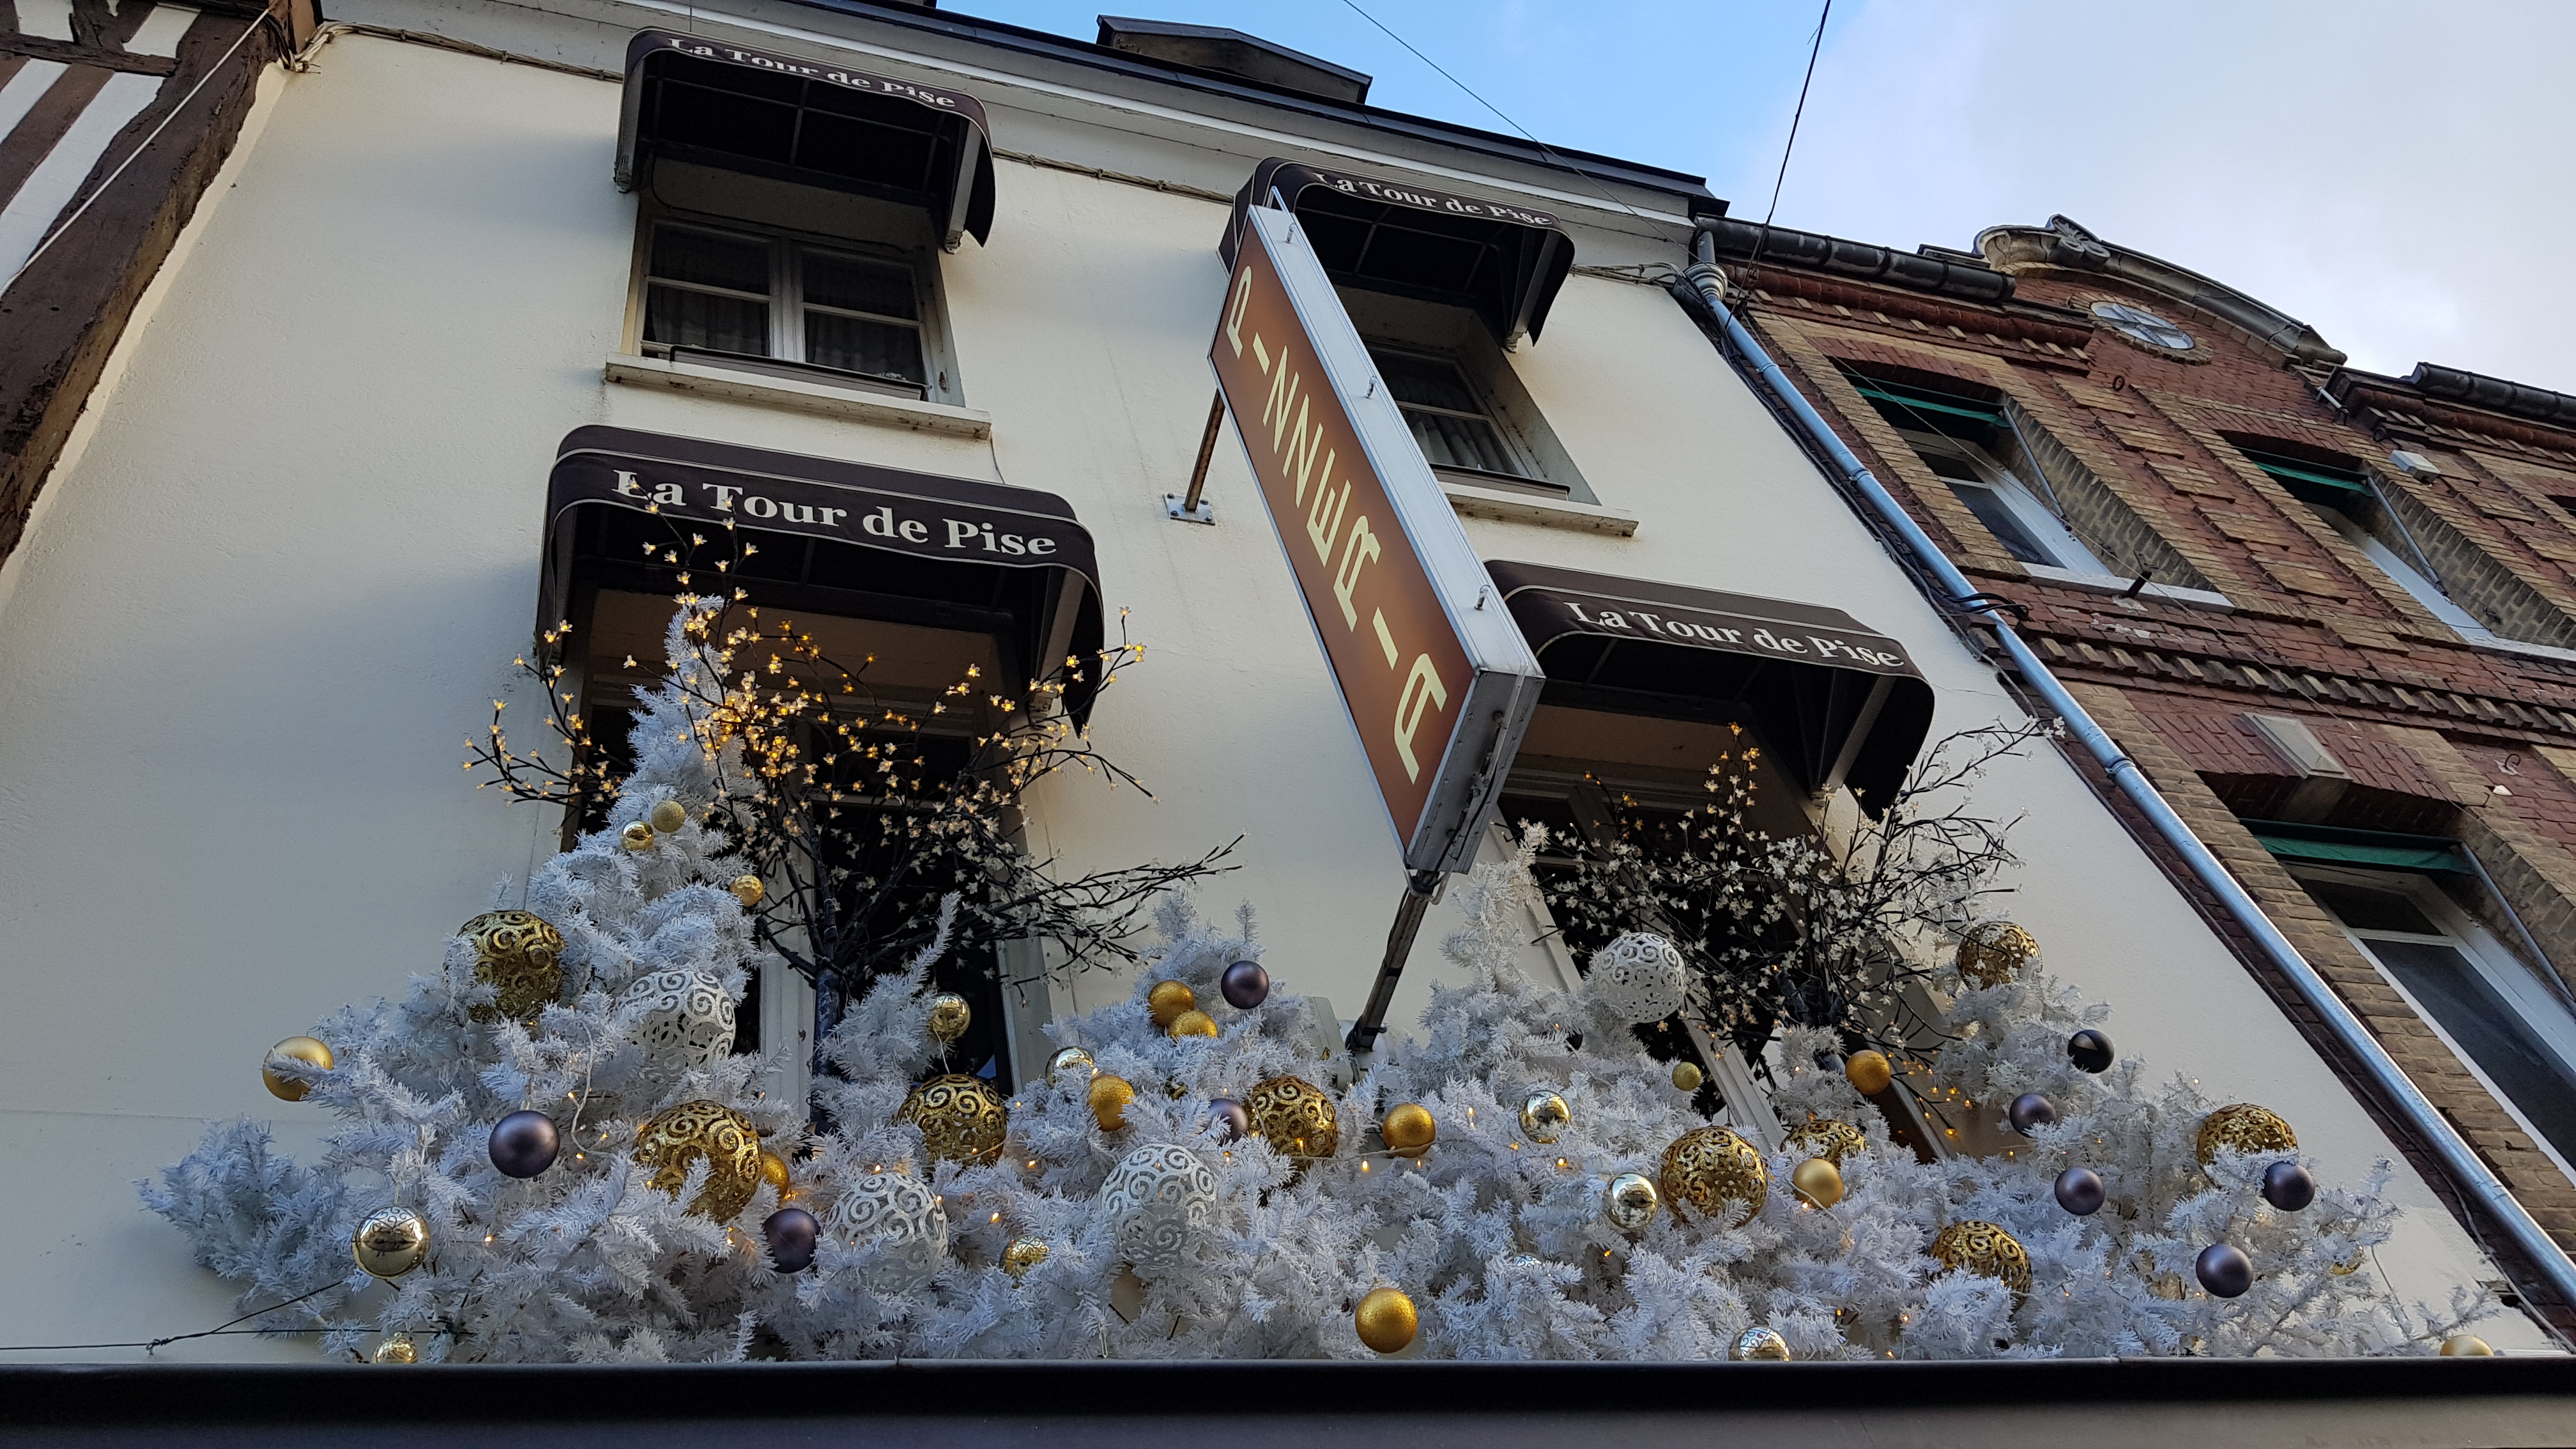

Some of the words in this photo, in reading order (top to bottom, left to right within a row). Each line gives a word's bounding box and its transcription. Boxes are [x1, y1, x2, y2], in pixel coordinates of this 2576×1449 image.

[668, 38, 713, 57] La
[724, 49, 819, 75] Tour
[827, 72, 871, 88] de
[880, 79, 956, 107] Pise
[1312, 172, 1358, 193] La
[1358, 181, 1437, 208] Tour
[1445, 197, 1483, 215] de
[1485, 204, 1552, 226] Pise
[611, 469, 687, 507] La
[702, 482, 847, 528] Tour
[862, 505, 928, 544] de
[942, 518, 1058, 556] Pise
[1226, 266, 1447, 785] PIZZERIA
[1563, 601, 1632, 629] La
[1629, 611, 1744, 644] Tour
[1752, 627, 1808, 654] de
[1805, 635, 1905, 667] Pise
